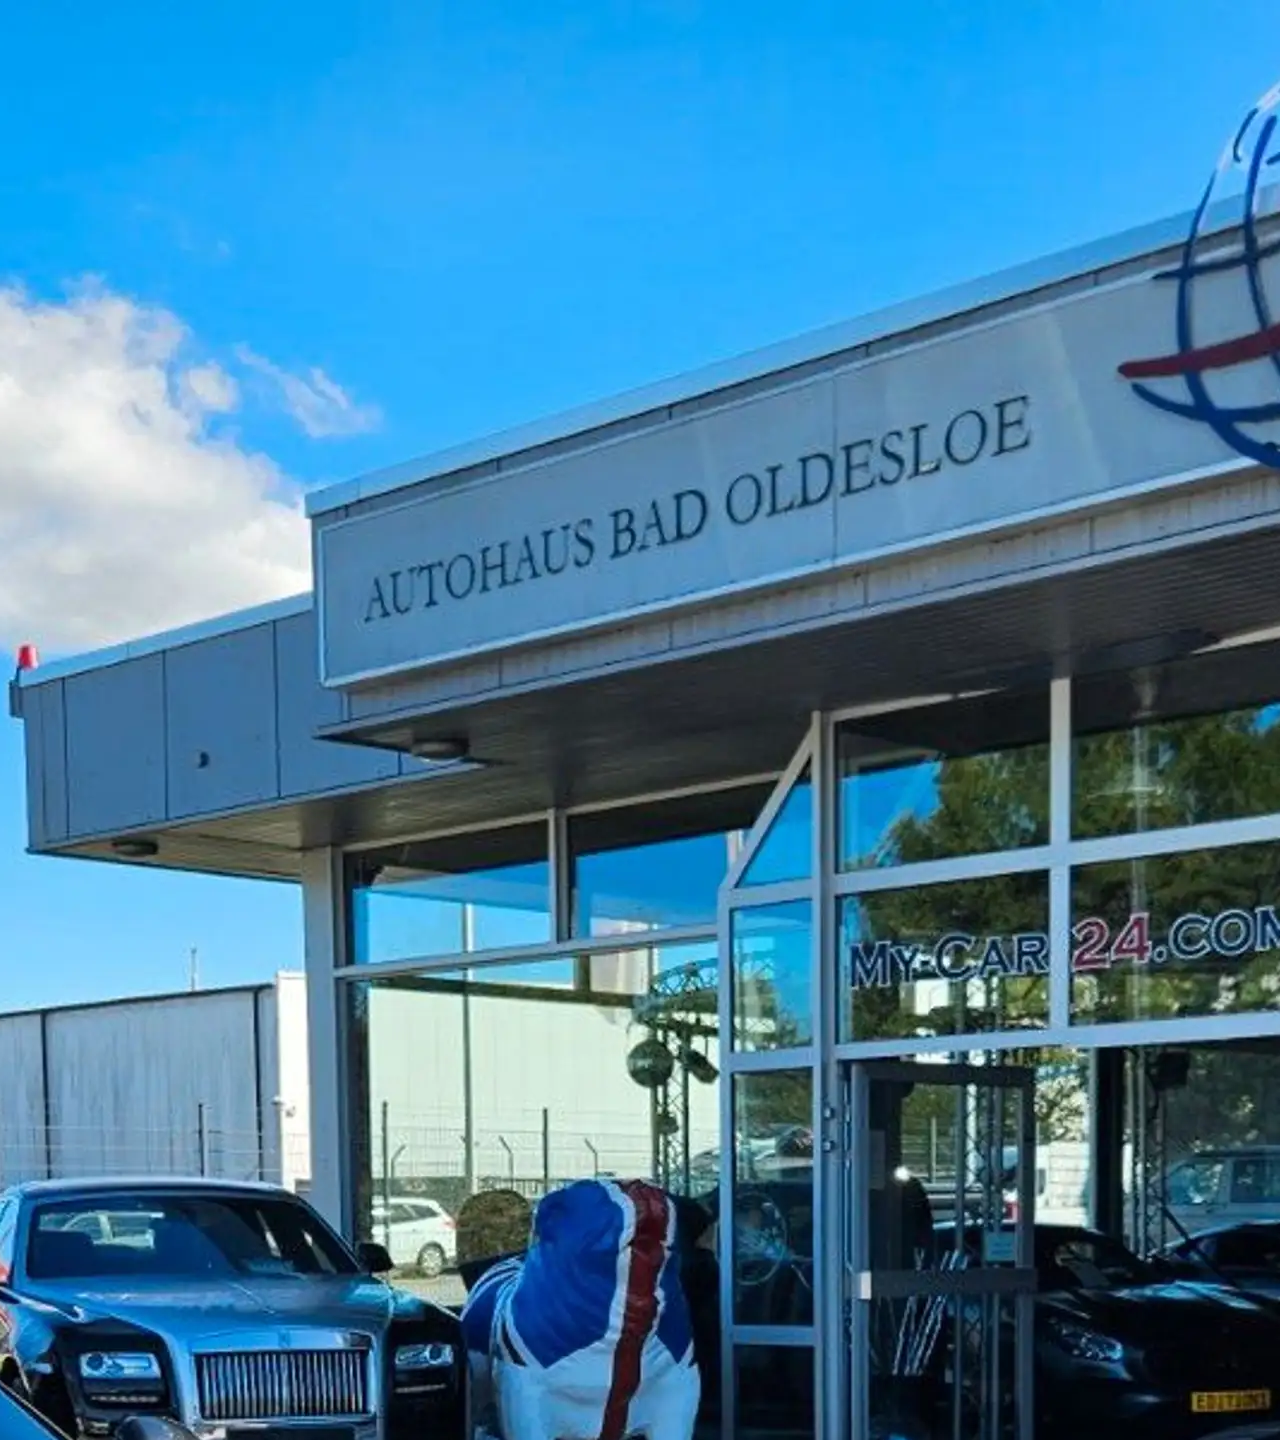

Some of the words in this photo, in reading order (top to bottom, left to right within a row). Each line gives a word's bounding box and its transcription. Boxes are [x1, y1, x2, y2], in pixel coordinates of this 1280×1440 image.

[364, 519, 595, 623] AUTOHAUS
[610, 488, 708, 560] BAD
[725, 395, 1032, 526] OLDESLOE
